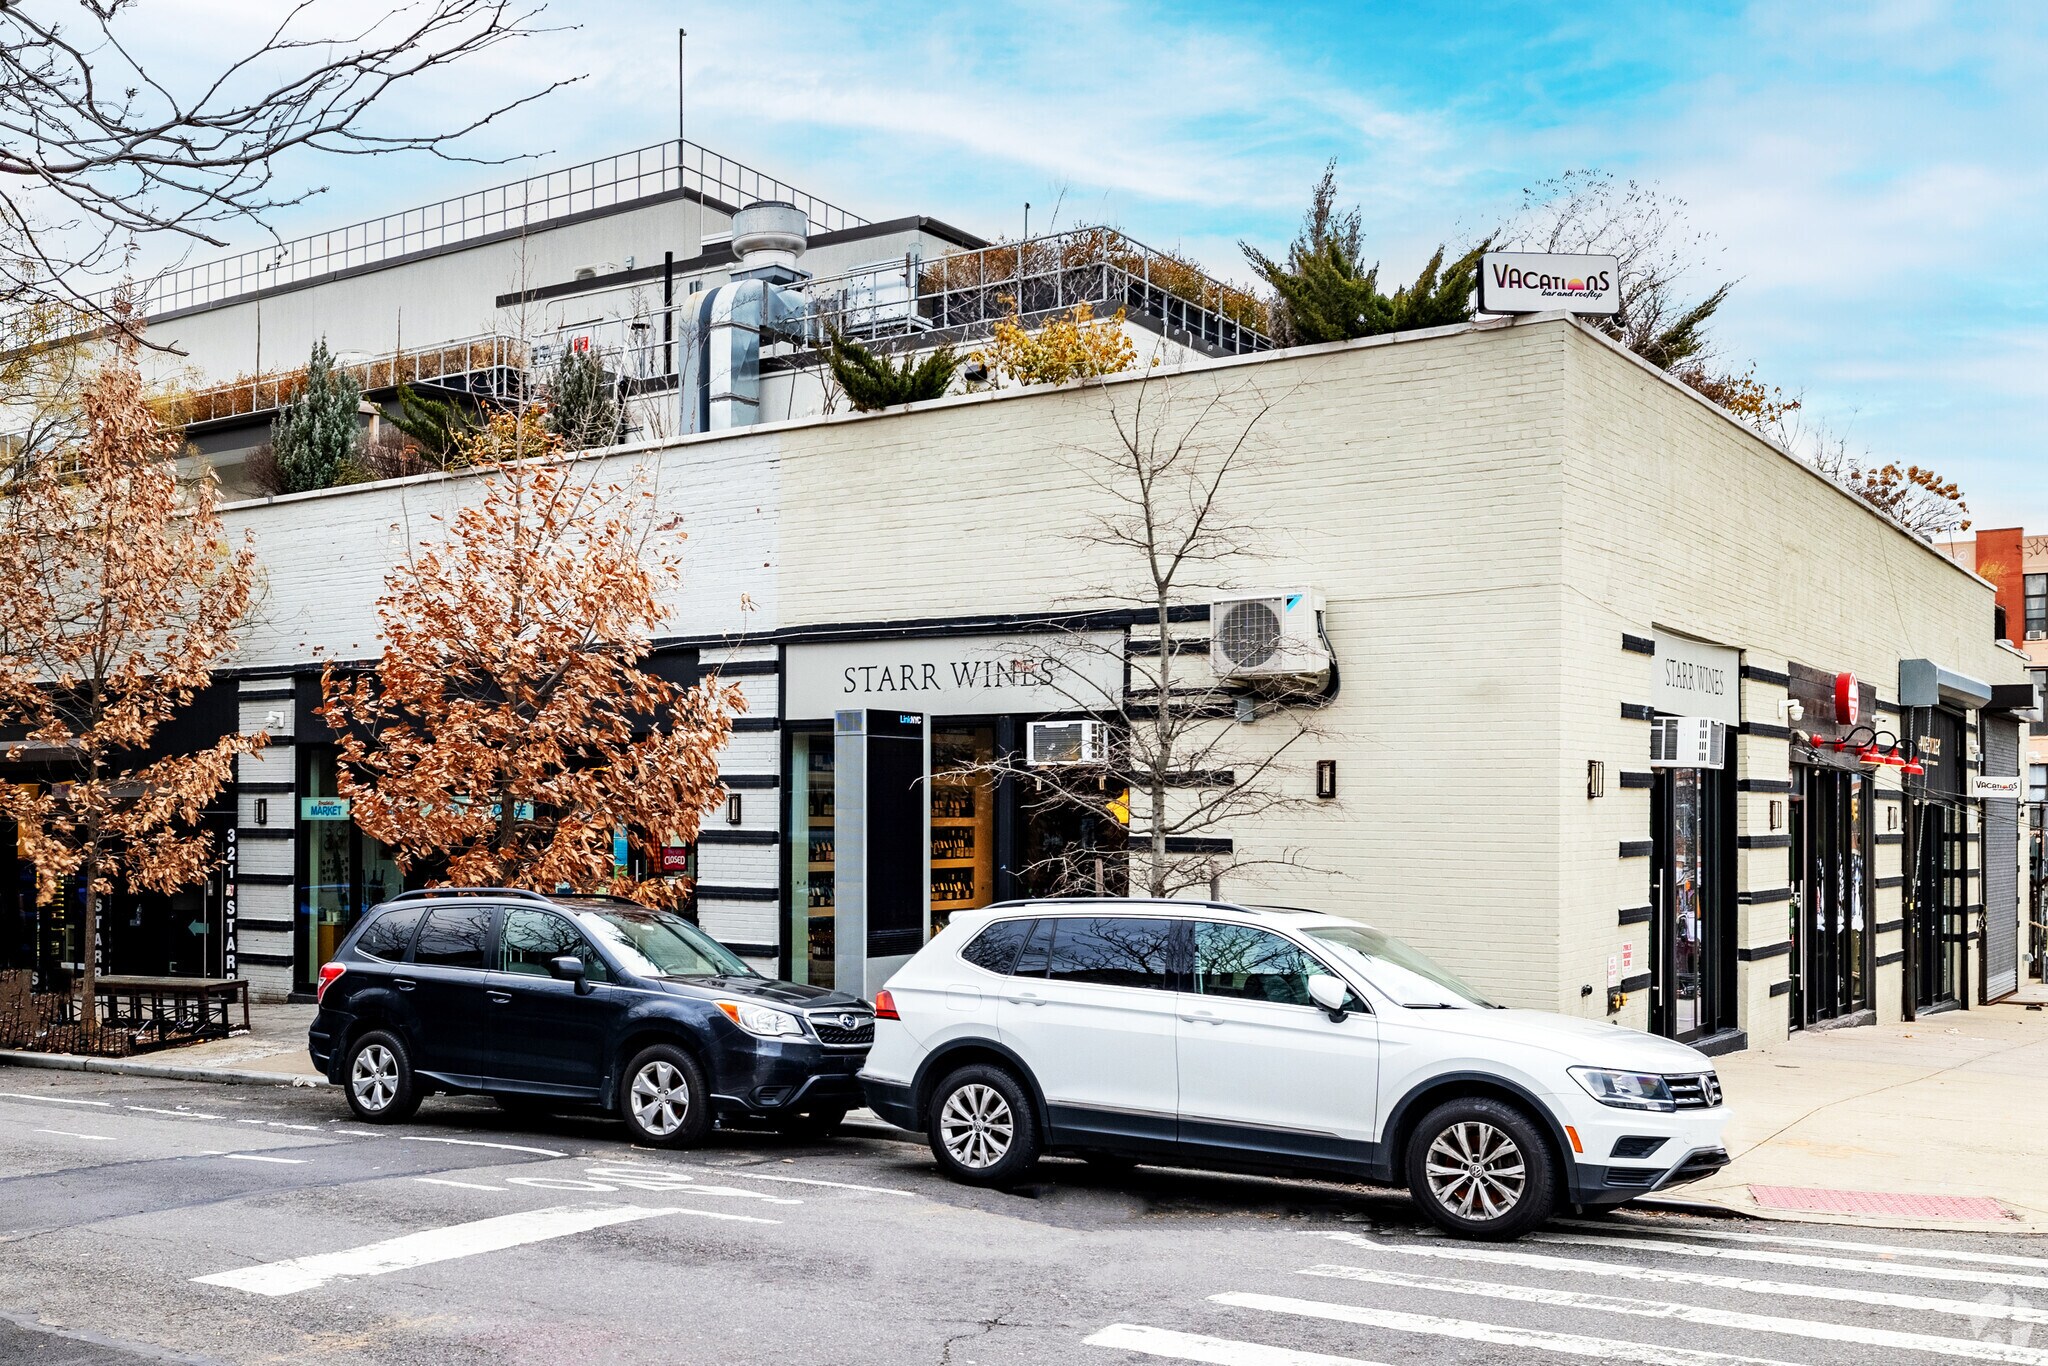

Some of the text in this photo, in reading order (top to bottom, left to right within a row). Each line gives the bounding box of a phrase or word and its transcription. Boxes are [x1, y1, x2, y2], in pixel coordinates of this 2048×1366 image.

[1541, 288, 1603, 301] bar and rooftop
[844, 658, 1054, 694] STARR WINES
[1665, 658, 1723, 695] STARR WINES
[900, 714, 922, 725] LinkNYC
[310, 805, 342, 816] MARKET
[664, 855, 686, 865] CLOSED
